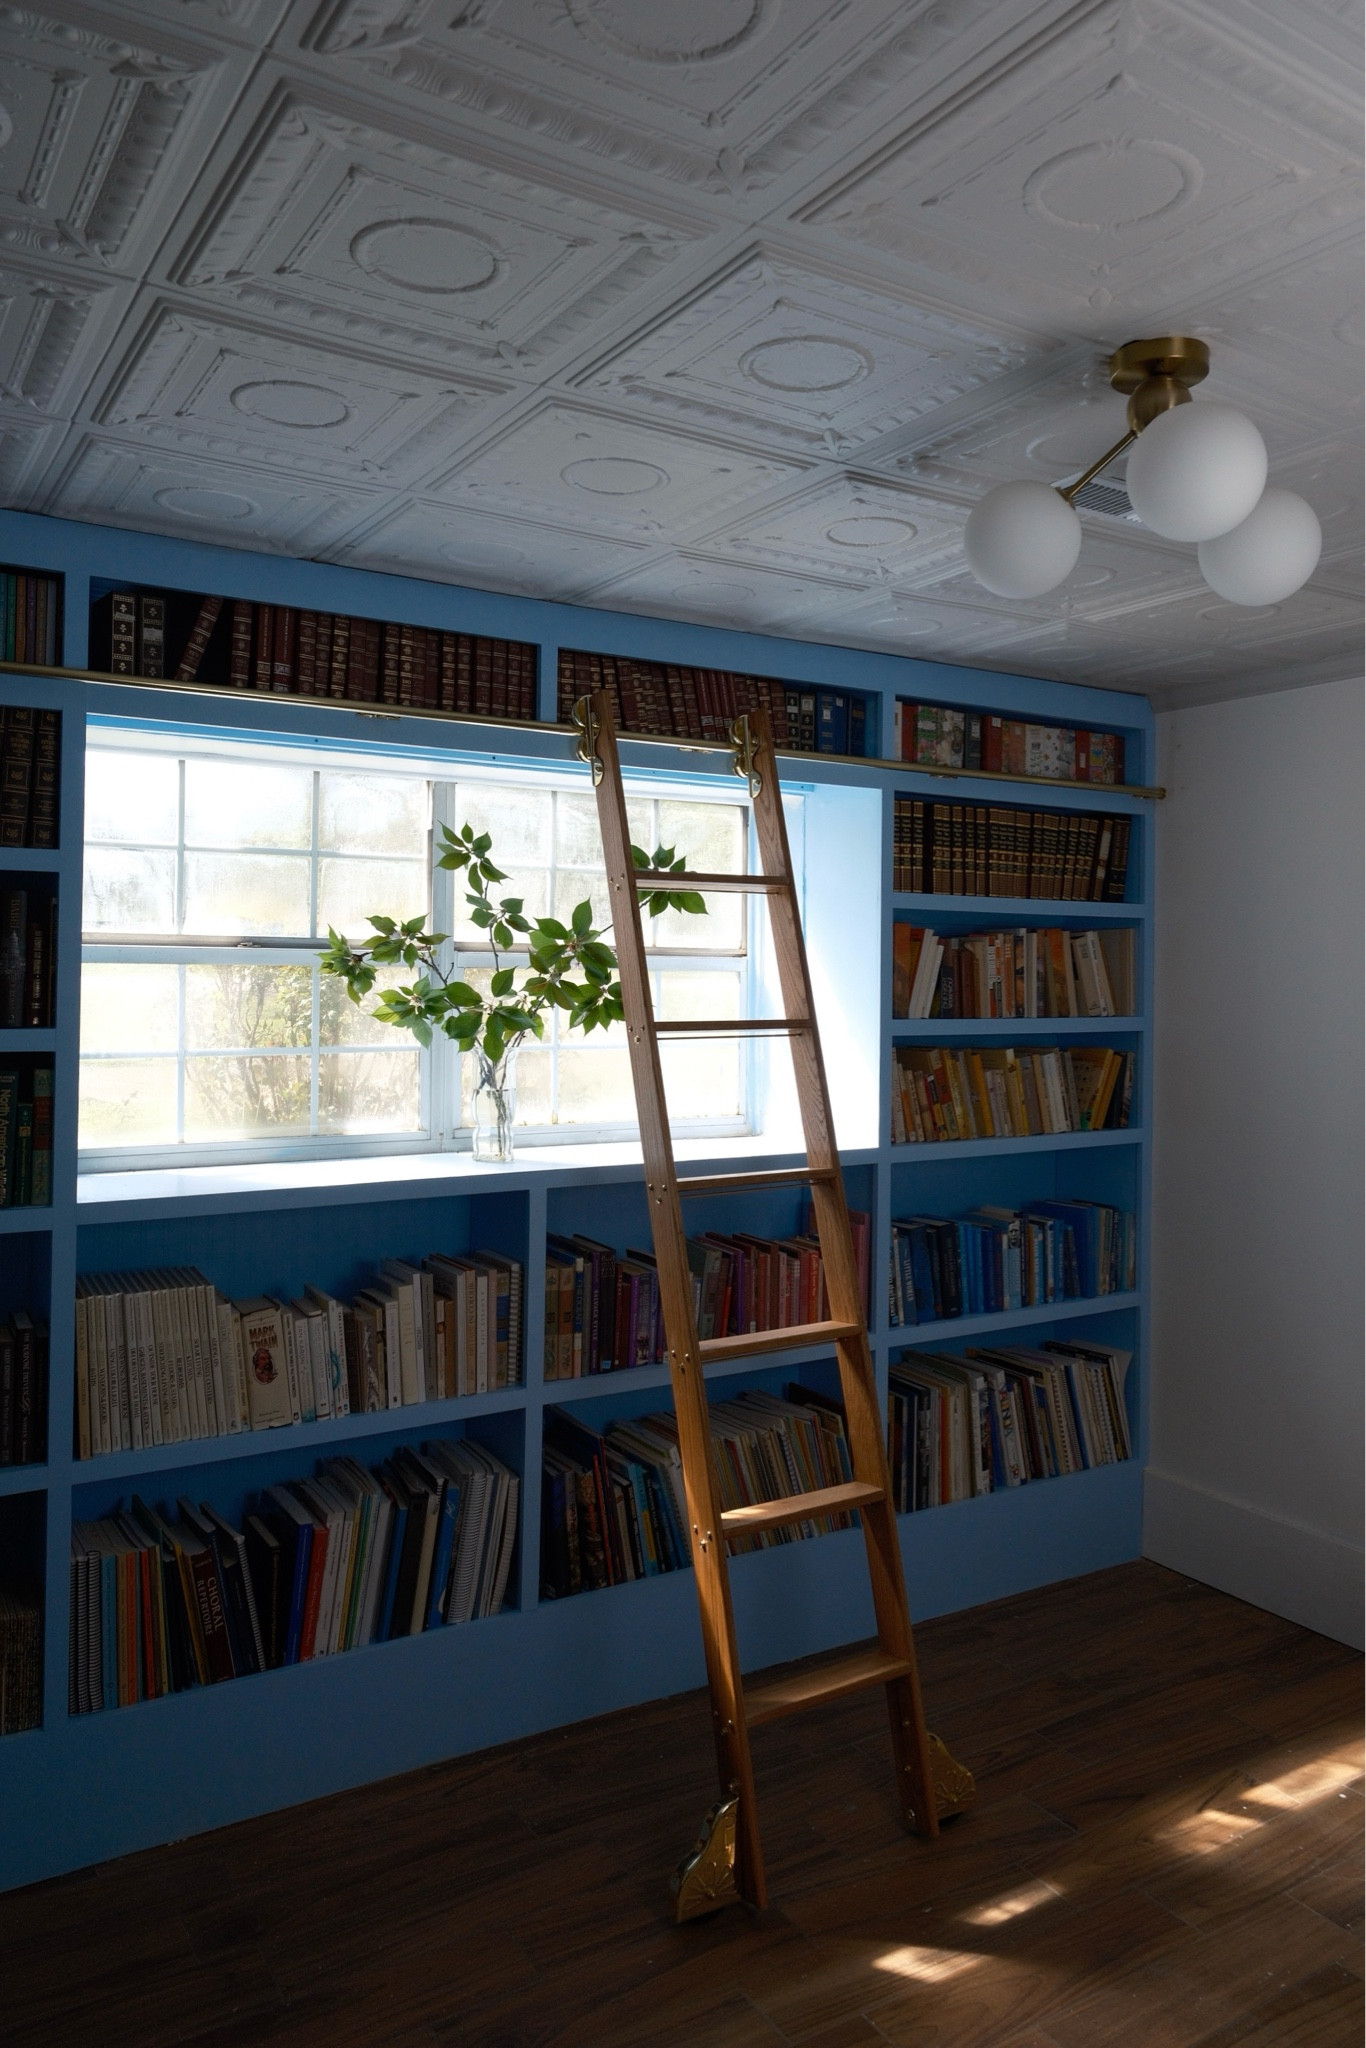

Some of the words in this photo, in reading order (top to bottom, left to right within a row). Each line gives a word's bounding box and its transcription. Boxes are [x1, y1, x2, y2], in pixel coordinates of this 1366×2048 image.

[0, 1089, 11, 1117] North
[0, 1120, 9, 1168] American
[904, 1260, 912, 1280] LITTLE
[906, 1280, 914, 1302] WOMEN
[249, 1325, 275, 1338] MARK
[250, 1335, 278, 1350] TWAIN
[22, 1344, 30, 1370] PURPOSE
[176, 1358, 184, 1388] BEDROOMS
[140, 1373, 148, 1406] BASEMENTS
[196, 1580, 213, 1636] REPERTOIRE
[207, 1577, 224, 1632] CHORAL
